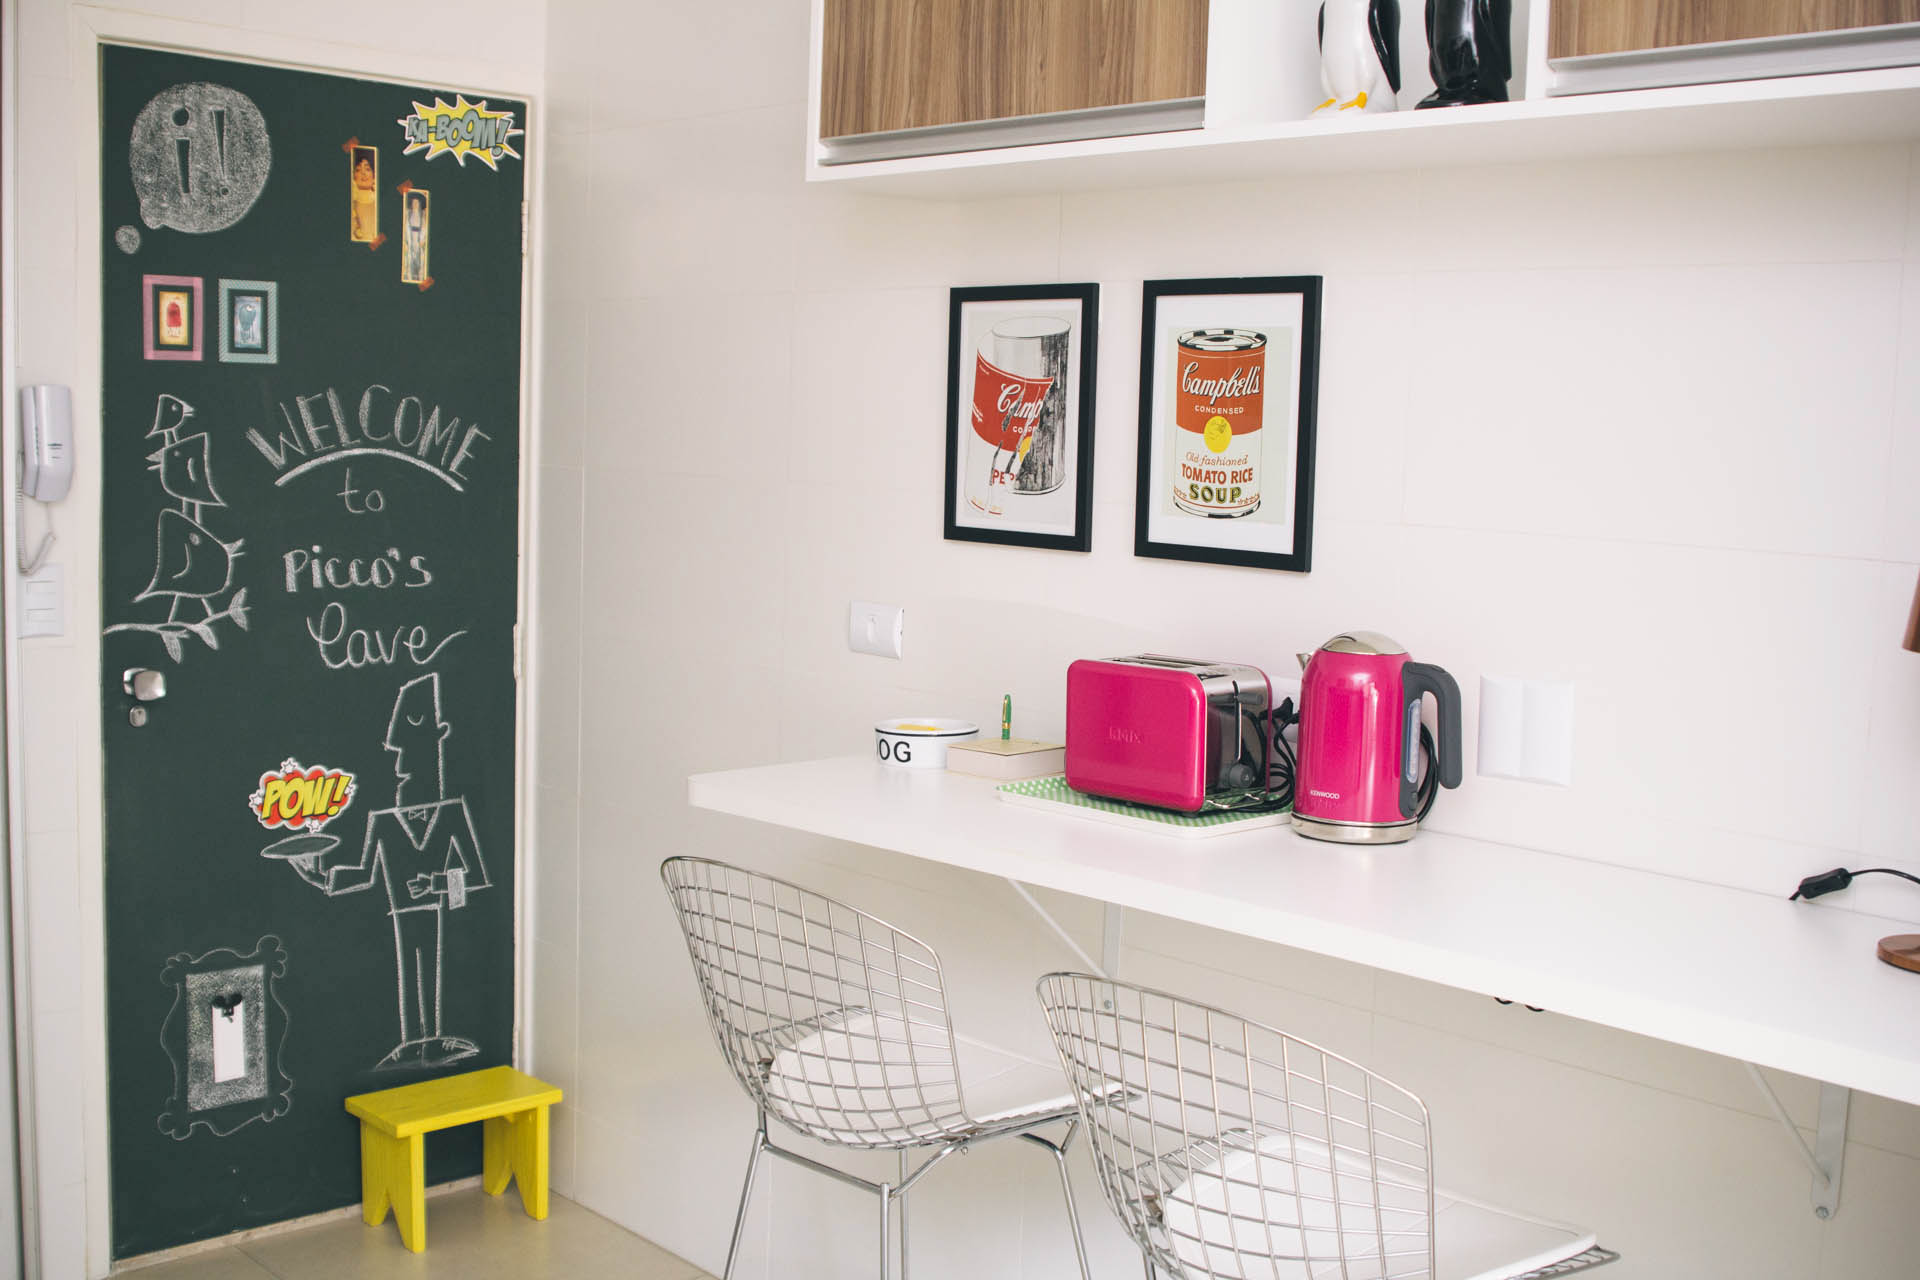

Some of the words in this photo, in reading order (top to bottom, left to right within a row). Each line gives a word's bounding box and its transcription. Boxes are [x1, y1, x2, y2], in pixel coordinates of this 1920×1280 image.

[408, 109, 510, 156] KA-BOOM!
[1182, 361, 1261, 406] Campbell's
[1194, 405, 1244, 415] CONDENSED
[246, 384, 491, 481] WELCOME
[1181, 463, 1227, 485] TOMATO
[1230, 467, 1253, 484] RICE
[1199, 454, 1249, 467] fashioned
[336, 467, 384, 514] to
[1189, 483, 1242, 504] SOUP
[261, 775, 352, 820] POW!
[1310, 789, 1340, 800] KENWOOD
